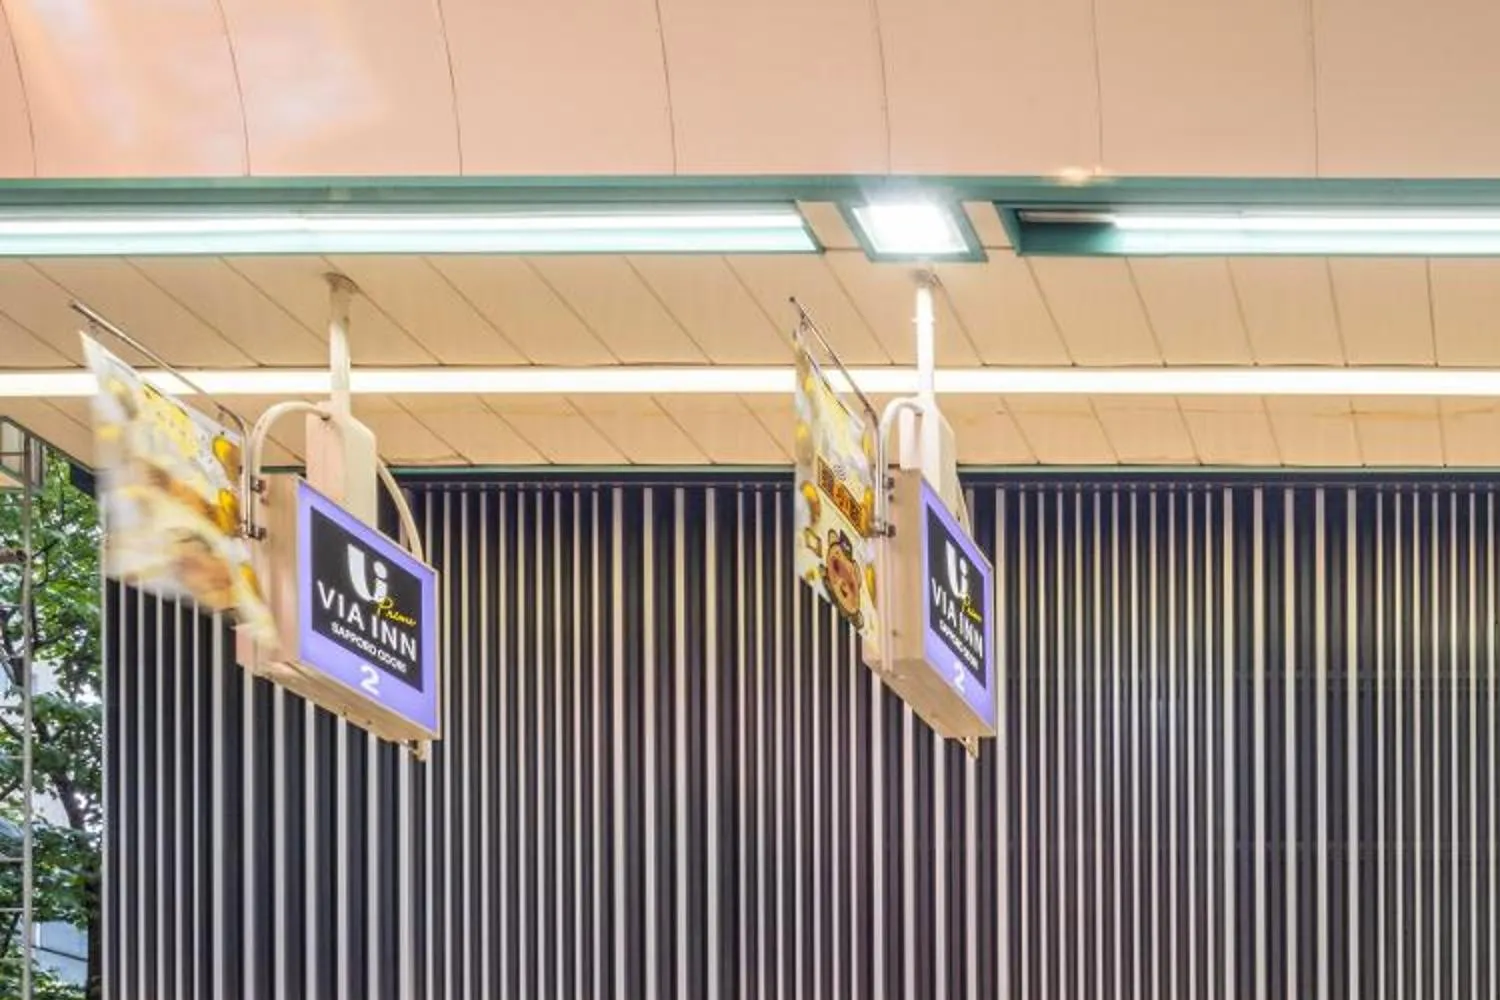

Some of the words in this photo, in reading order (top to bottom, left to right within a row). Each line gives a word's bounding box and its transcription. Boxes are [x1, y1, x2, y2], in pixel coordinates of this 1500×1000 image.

[317, 579, 366, 631] VIA
[371, 614, 417, 662] INN
[931, 577, 957, 628] VIA
[959, 611, 983, 659] INN
[359, 665, 381, 696] 2
[953, 662, 967, 692] 2
